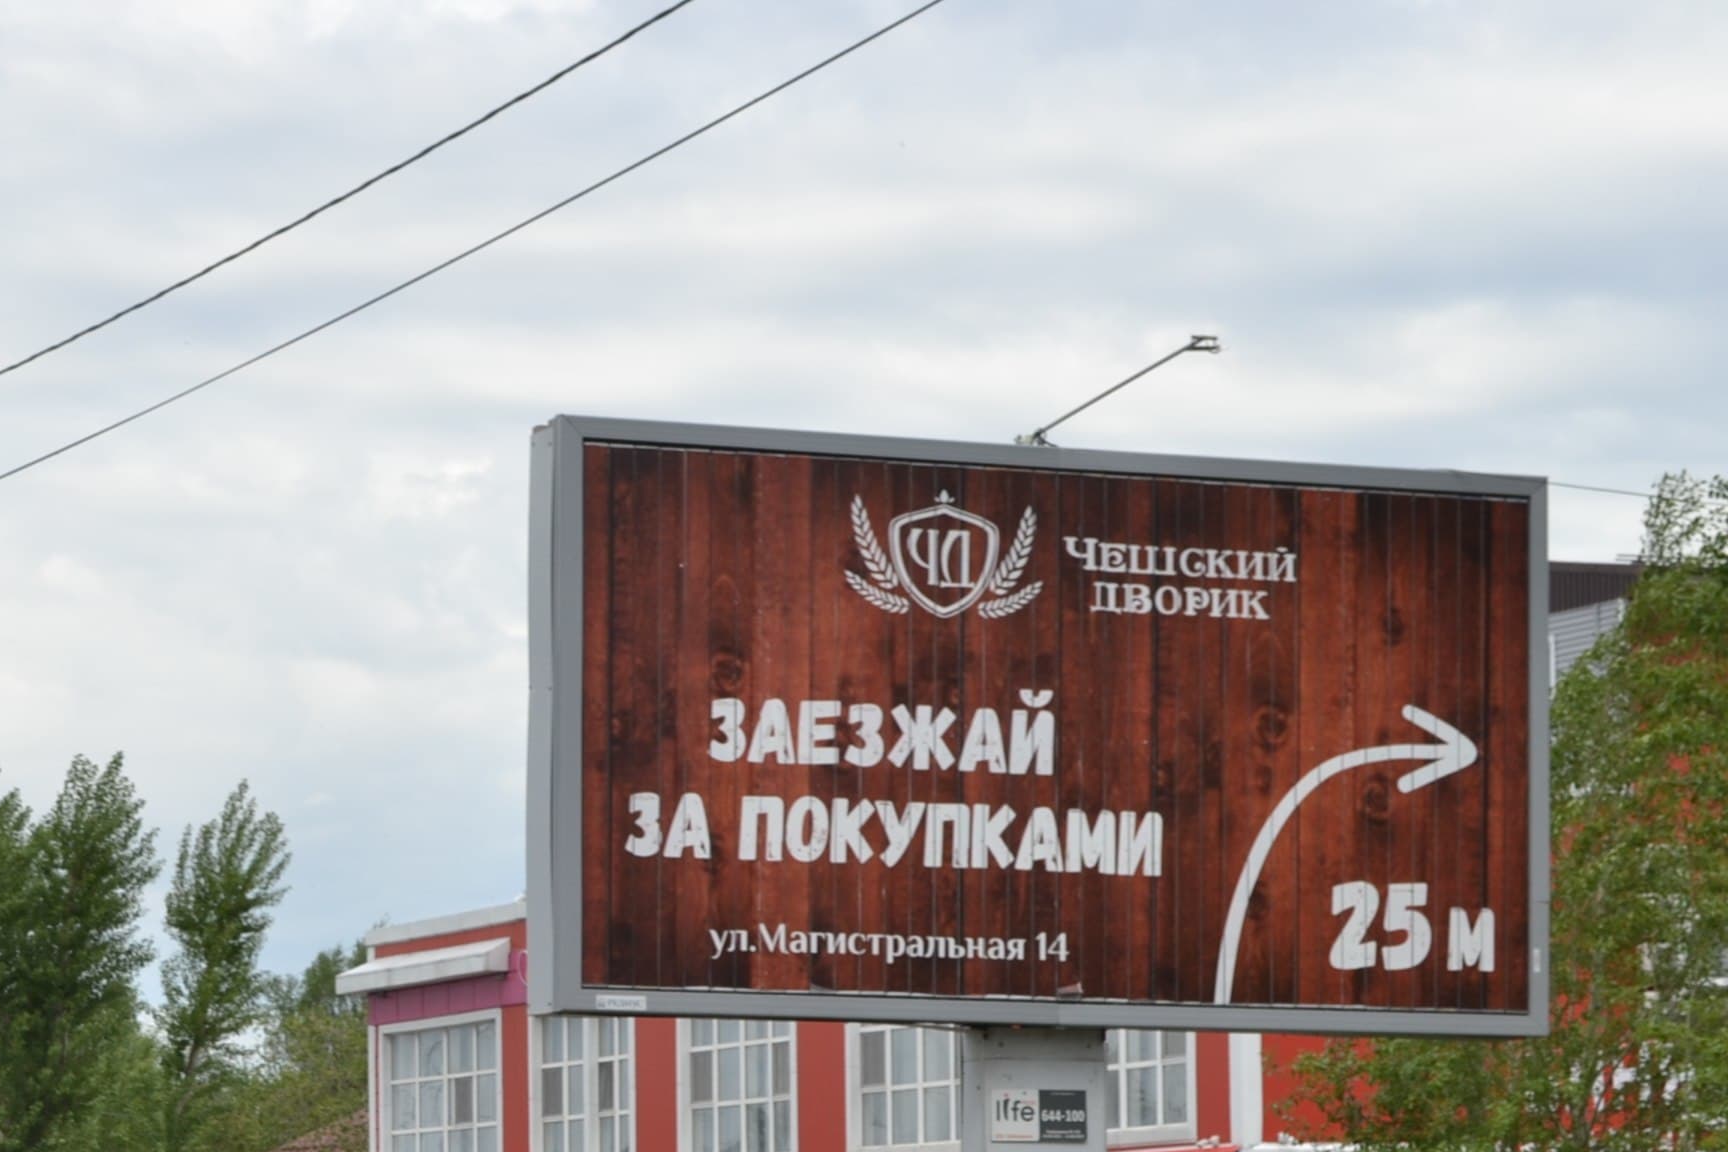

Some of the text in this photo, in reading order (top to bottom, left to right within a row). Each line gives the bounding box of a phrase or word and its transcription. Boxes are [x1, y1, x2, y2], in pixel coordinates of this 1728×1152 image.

[906, 527, 975, 589] ЧД
[1063, 536, 1297, 582] ЧЕШСКИЙ
[1090, 580, 1271, 620] ДВОРИК
[707, 689, 1055, 775] ЗАЕЗЖАЙ
[624, 791, 1163, 877] ЗА ПОКУПКАМИ
[1036, 932, 1069, 962] 14
[1329, 881, 1432, 971] 25
[996, 1093, 1035, 1122] life
[1041, 1109, 1085, 1122] 644-100
